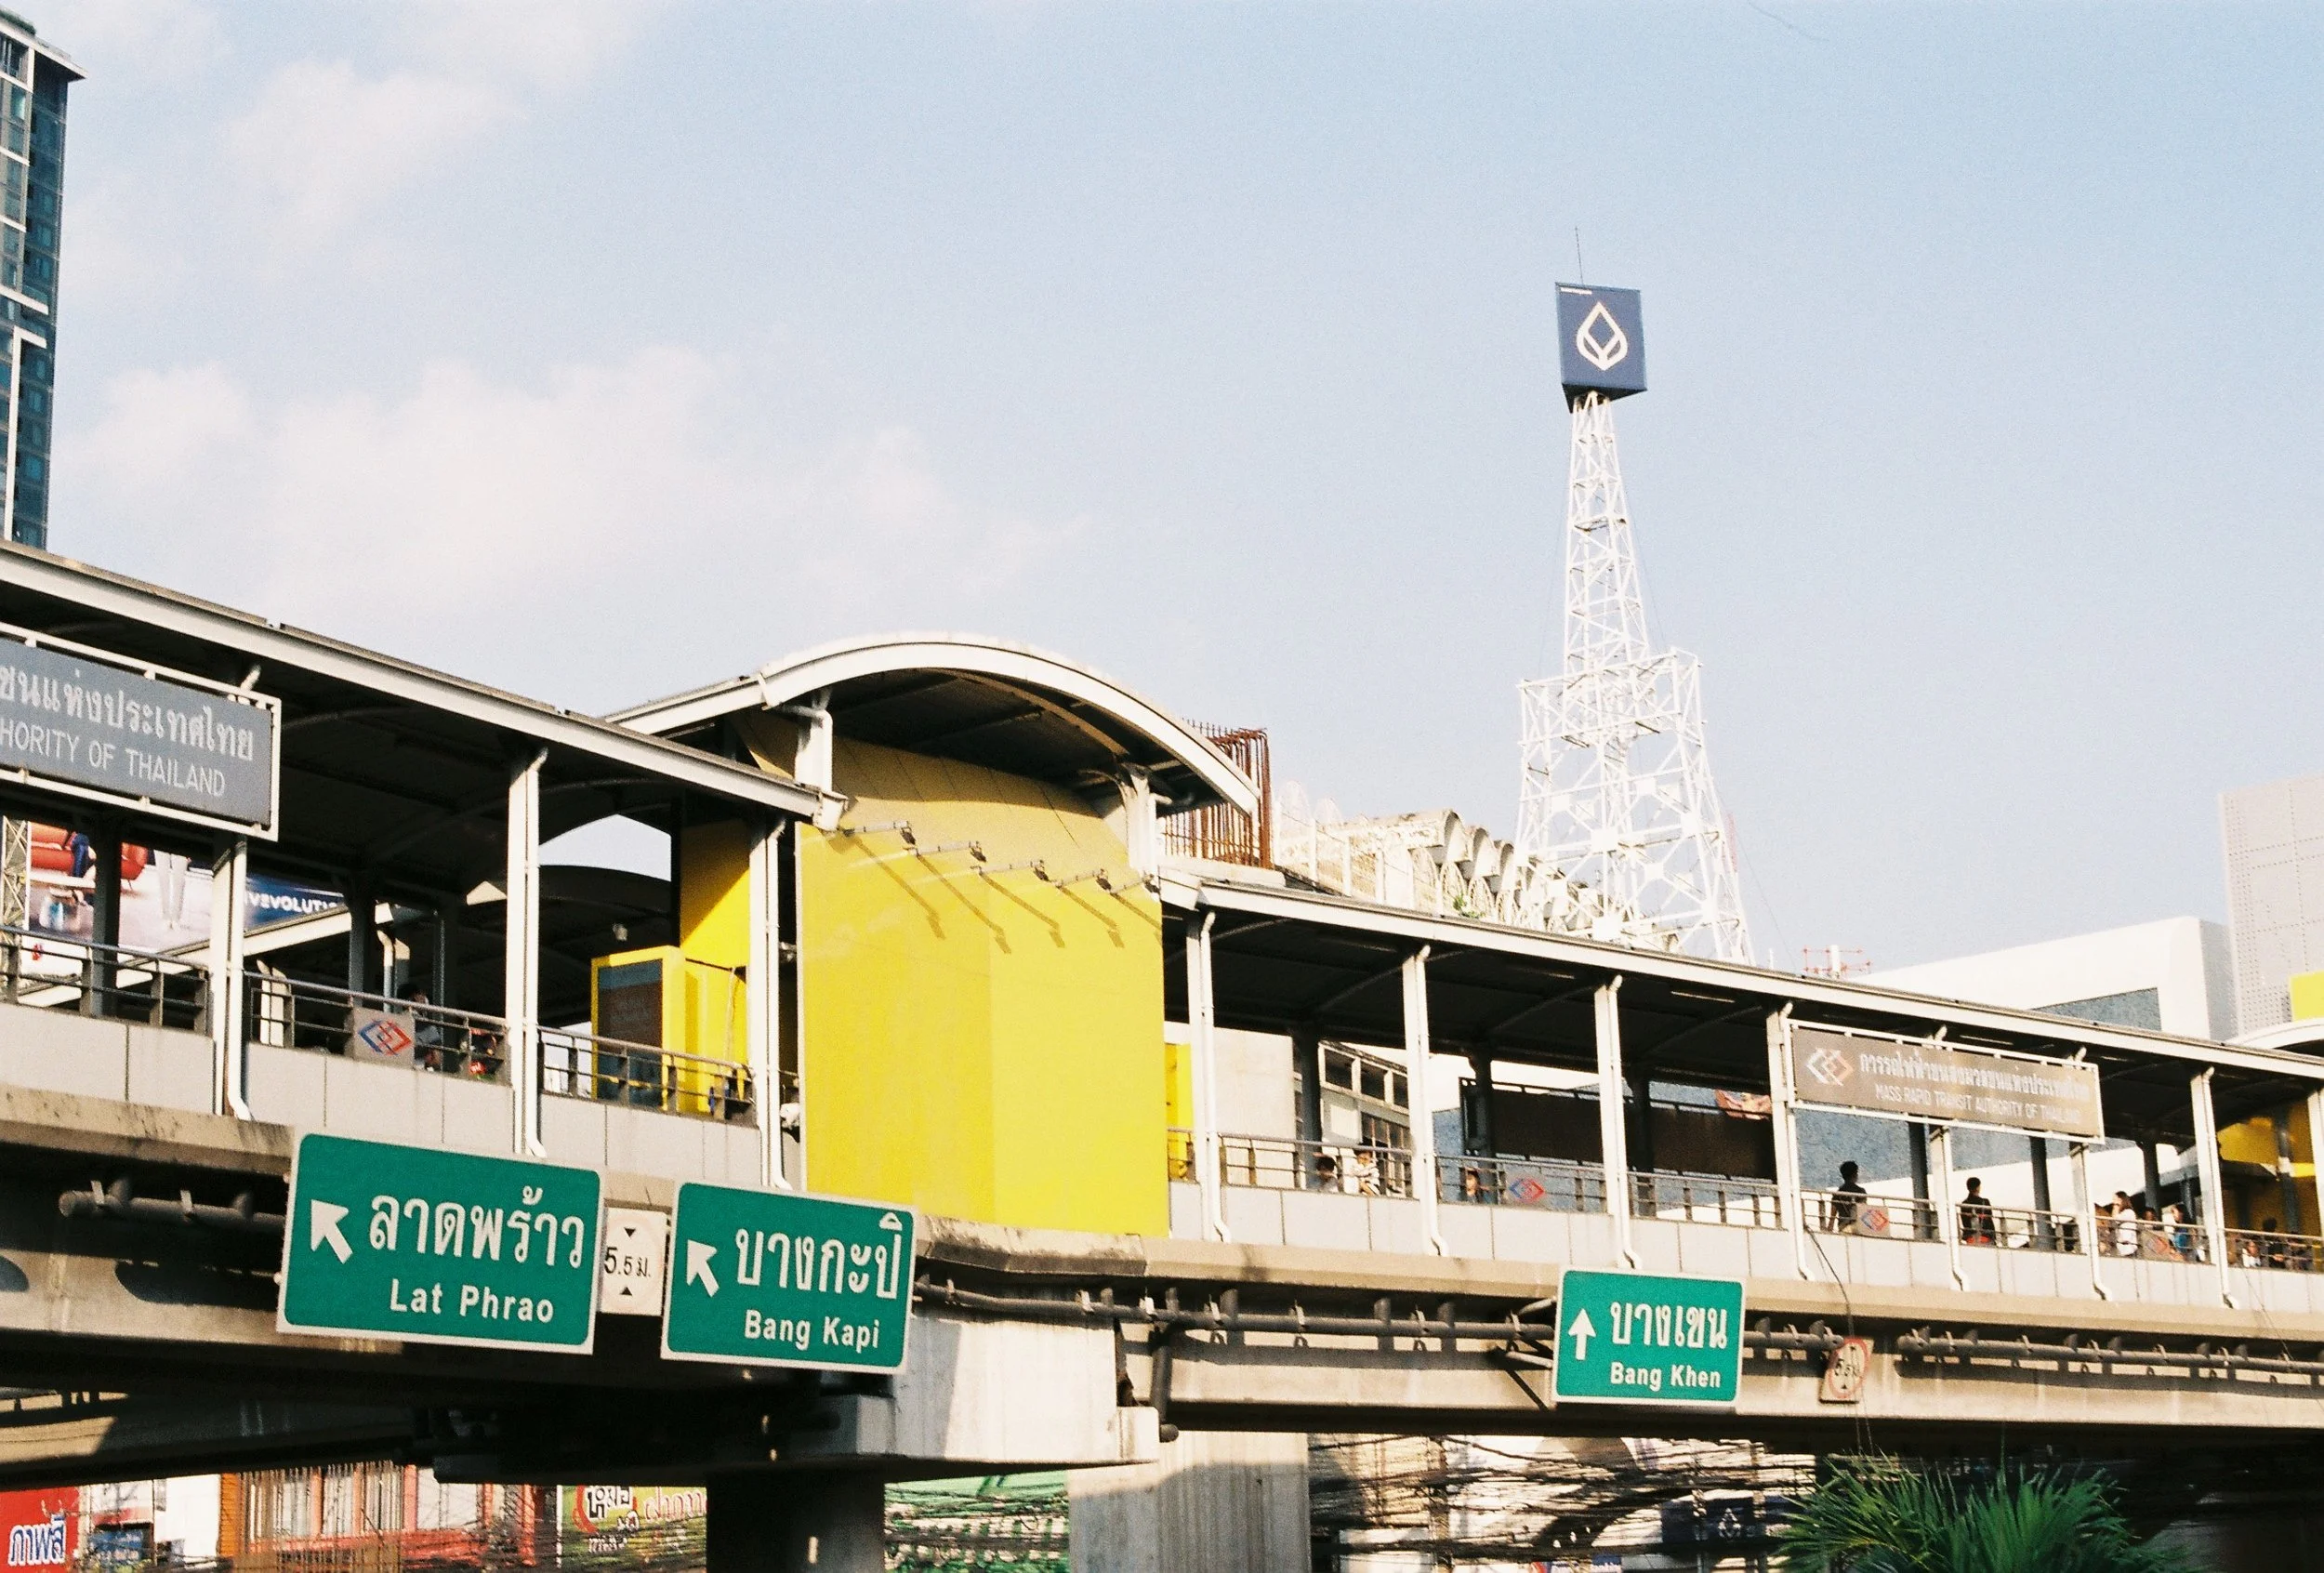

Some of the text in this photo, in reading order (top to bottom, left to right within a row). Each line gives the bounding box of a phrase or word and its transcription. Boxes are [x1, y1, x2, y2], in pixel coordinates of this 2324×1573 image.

[88, 739, 117, 772] OF
[125, 747, 226, 798] THAILAND
[1875, 1082, 1903, 1103] MASS
[2024, 1102, 2039, 1120] OF
[369, 1185, 585, 1269] ลาดพร้าว
[735, 1211, 904, 1300] บางกะปิ
[390, 1278, 554, 1324] Lat Phrao
[744, 1308, 880, 1355] Bang Kapi
[1609, 1302, 1728, 1350] บางเขน
[1609, 1361, 1722, 1393] Bang Khen
